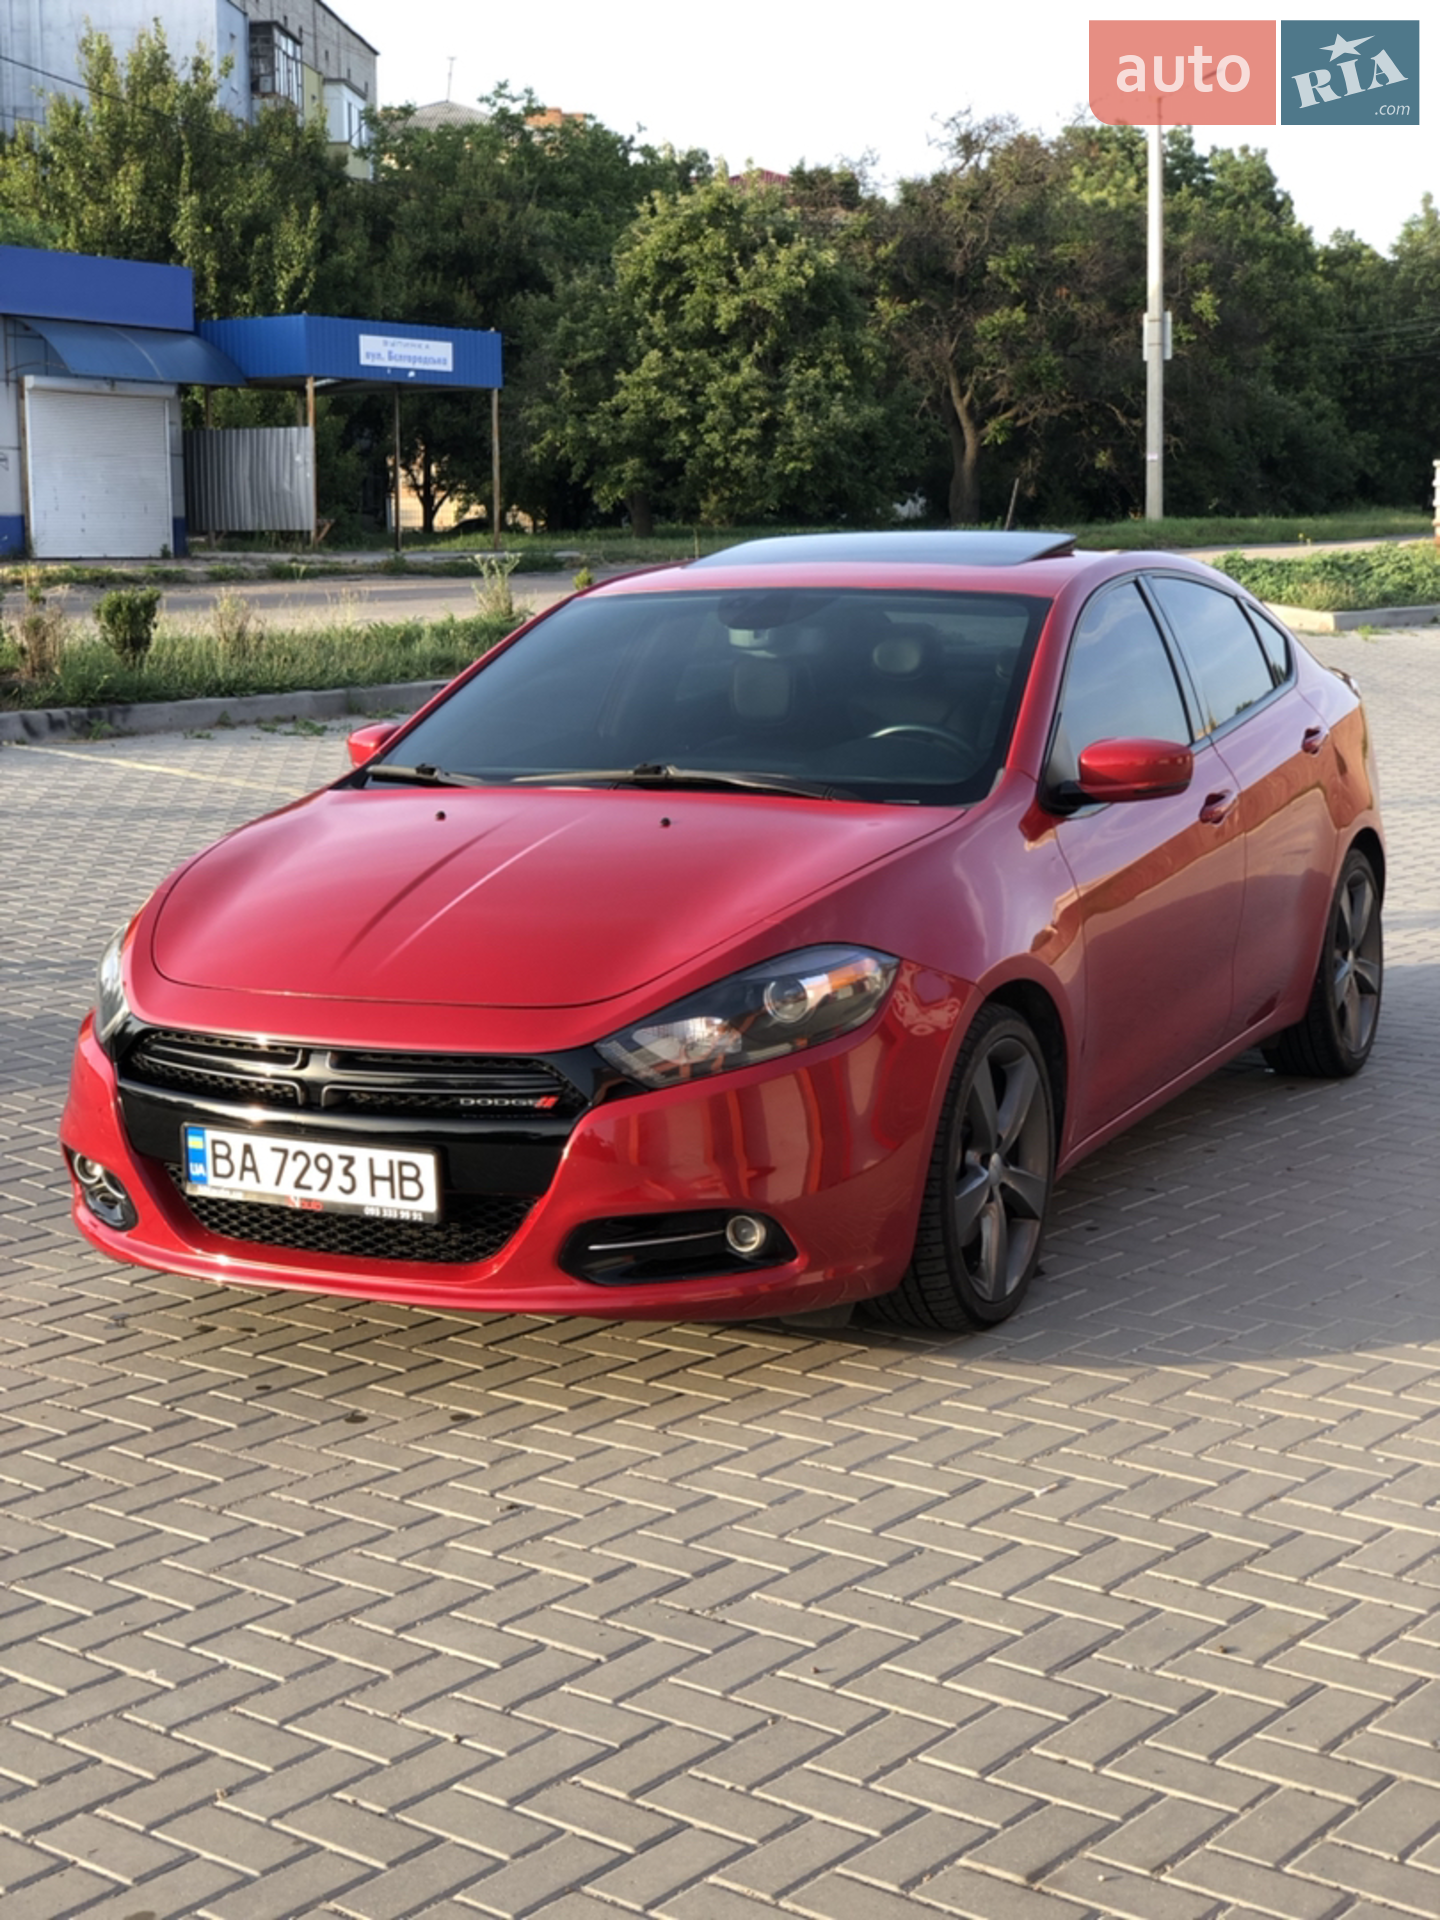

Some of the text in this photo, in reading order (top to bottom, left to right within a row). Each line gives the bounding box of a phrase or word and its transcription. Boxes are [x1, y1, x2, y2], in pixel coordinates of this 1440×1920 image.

[190, 1162, 206, 1176] UA
[211, 1139, 424, 1202] BA 7293 HB
